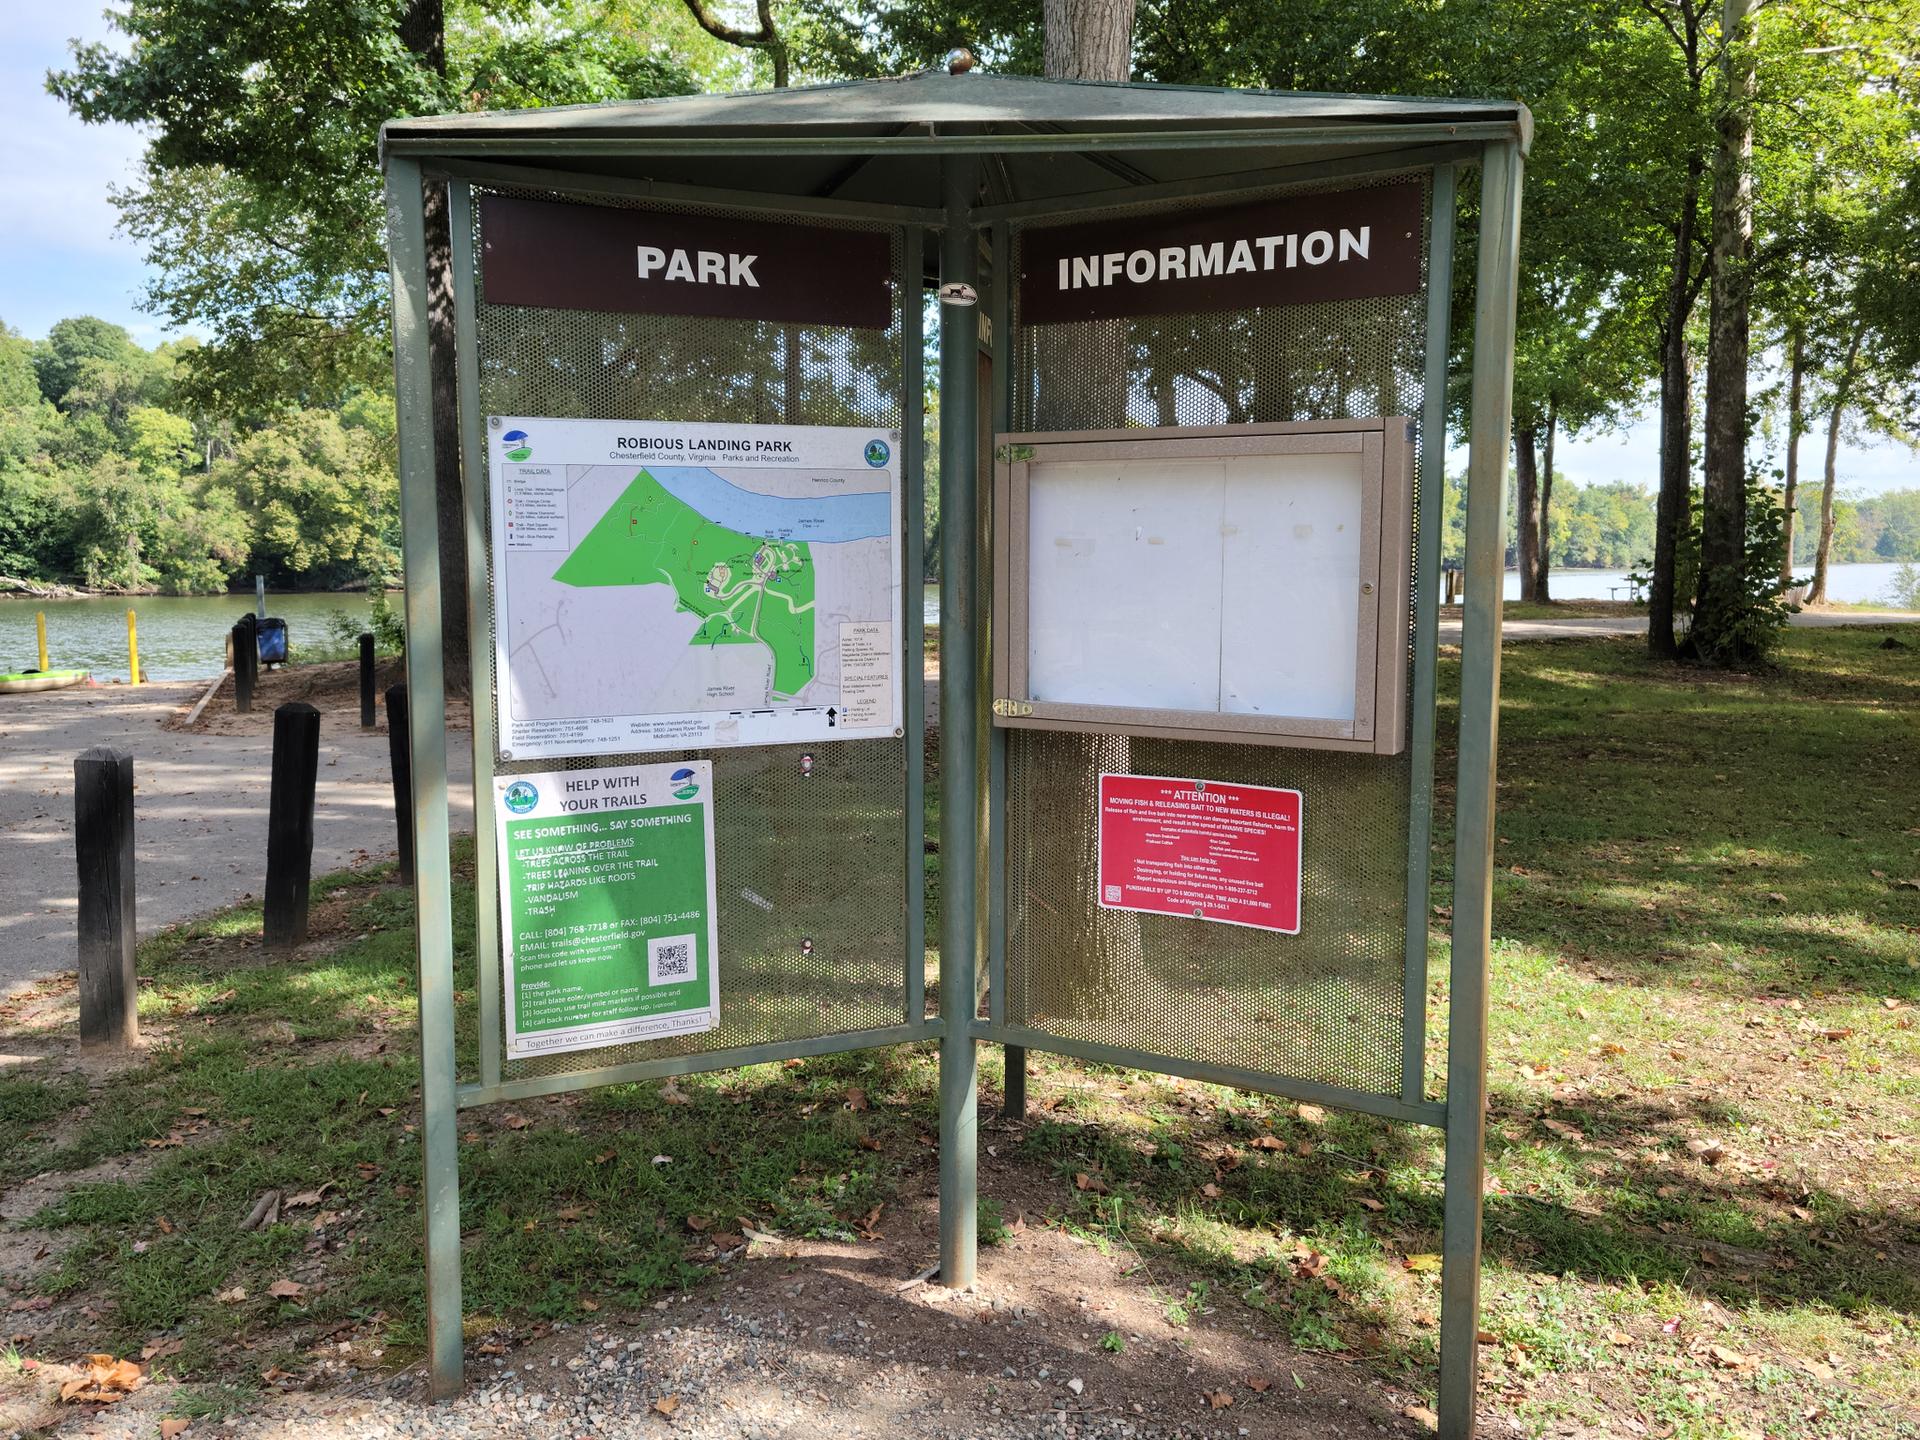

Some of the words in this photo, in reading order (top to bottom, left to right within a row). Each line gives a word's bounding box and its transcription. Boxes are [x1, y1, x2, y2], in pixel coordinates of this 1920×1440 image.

[637, 245, 760, 288] PARK
[1058, 226, 1371, 290] INFORMATION
[617, 436, 683, 449] ROBIOUS
[689, 438, 750, 450] LANDING
[755, 440, 791, 451] PARK
[609, 451, 655, 459] Chesterfield
[657, 452, 685, 460] County,
[688, 453, 715, 461] Virginia
[745, 454, 758, 462] and
[761, 455, 799, 463] Recreation
[566, 778, 599, 792] HELP
[603, 774, 639, 789] WITH
[560, 797, 597, 812] YOUR
[603, 793, 646, 808] TRAILS
[1173, 790, 1225, 803] ATTENTION
[1155, 800, 1189, 809] RELEASING
[1190, 803, 1205, 811] BAIT
[1229, 807, 1254, 816] WATERS
[1262, 811, 1290, 821] ILLEGAL!
[513, 829, 531, 840] SEE
[535, 822, 606, 838] SOMETHING...
[609, 820, 627, 830] SAY
[630, 813, 691, 828] SOMETHING
[515, 847, 529, 857] LET
[532, 846, 543, 855] US
[545, 843, 572, 854] KNOW
[575, 842, 586, 851] OF
[589, 837, 634, 849] PROBLEMS
[553, 854, 585, 865] ACROSS
[588, 852, 603, 861] THE
[606, 849, 629, 859] TRAIL
[554, 865, 590, 877] LEANING
[593, 863, 615, 873] OVER
[618, 861, 632, 870] THE
[635, 858, 657, 868] TRAIL
[547, 877, 586, 889] HAZARDS
[589, 875, 605, 885] LIKE
[608, 872, 635, 883] ROOTS
[519, 929, 542, 941] CALL:
[569, 921, 607, 935] 768-7718
[610, 921, 618, 929] or
[620, 918, 637, 928] FAX:
[663, 910, 700, 923] 751-4486
[520, 941, 549, 953] EMAIL:
[552, 929, 645, 949] trails@chesterfield.gov
[520, 953, 535, 961] Scan
[537, 951, 550, 959] this
[552, 949, 567, 957] code
[570, 947, 584, 955] with
[586, 946, 600, 954] your
[602, 942, 621, 951] smart
[520, 962, 542, 972] phone
[544, 960, 556, 968] and
[578, 955, 595, 963] know
[521, 979, 550, 989] Provide:
[546, 988, 560, 996] park
[533, 998, 546, 1006] trail
[548, 995, 565, 1004] blaze
[567, 990, 609, 1002] color/symbol
[533, 1005, 562, 1016] location,
[577, 1001, 590, 1009] trail
[593, 999, 605, 1007] mile
[607, 995, 633, 1005] markers
[641, 991, 666, 1001] possible
[533, 1017, 545, 1025] call
[547, 1015, 561, 1023] back
[564, 1011, 589, 1021] number
[591, 1009, 601, 1017] for
[603, 1007, 617, 1015] staff
[526, 1036, 562, 1050] Together
[565, 1035, 577, 1043] we
[579, 1033, 593, 1041] can
[596, 1028, 617, 1039] make
[627, 1020, 669, 1035] difference,
[672, 1016, 701, 1028] Thanks!
